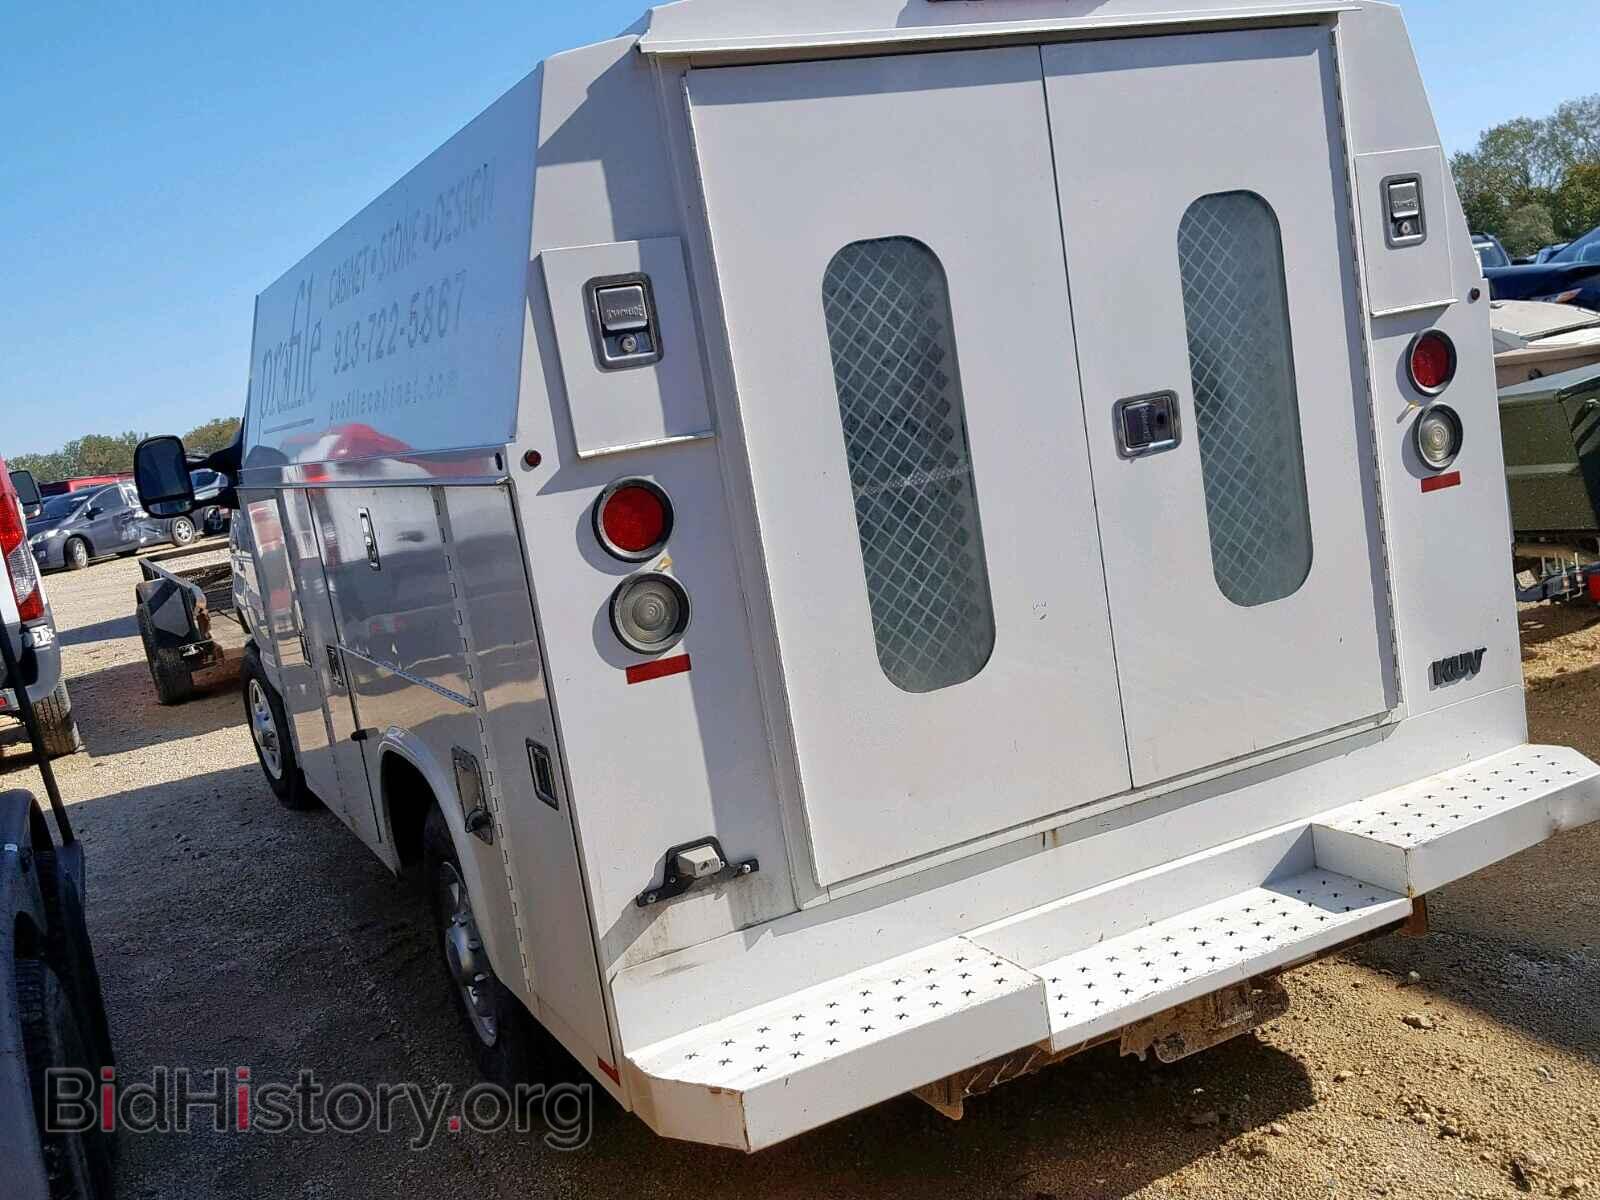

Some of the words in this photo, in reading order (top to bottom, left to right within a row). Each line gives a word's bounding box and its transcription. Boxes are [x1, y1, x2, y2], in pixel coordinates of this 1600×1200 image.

[431, 156, 497, 252] DESIGN
[333, 267, 468, 375] 913-722-5867
[1431, 646, 1488, 687] KUV
